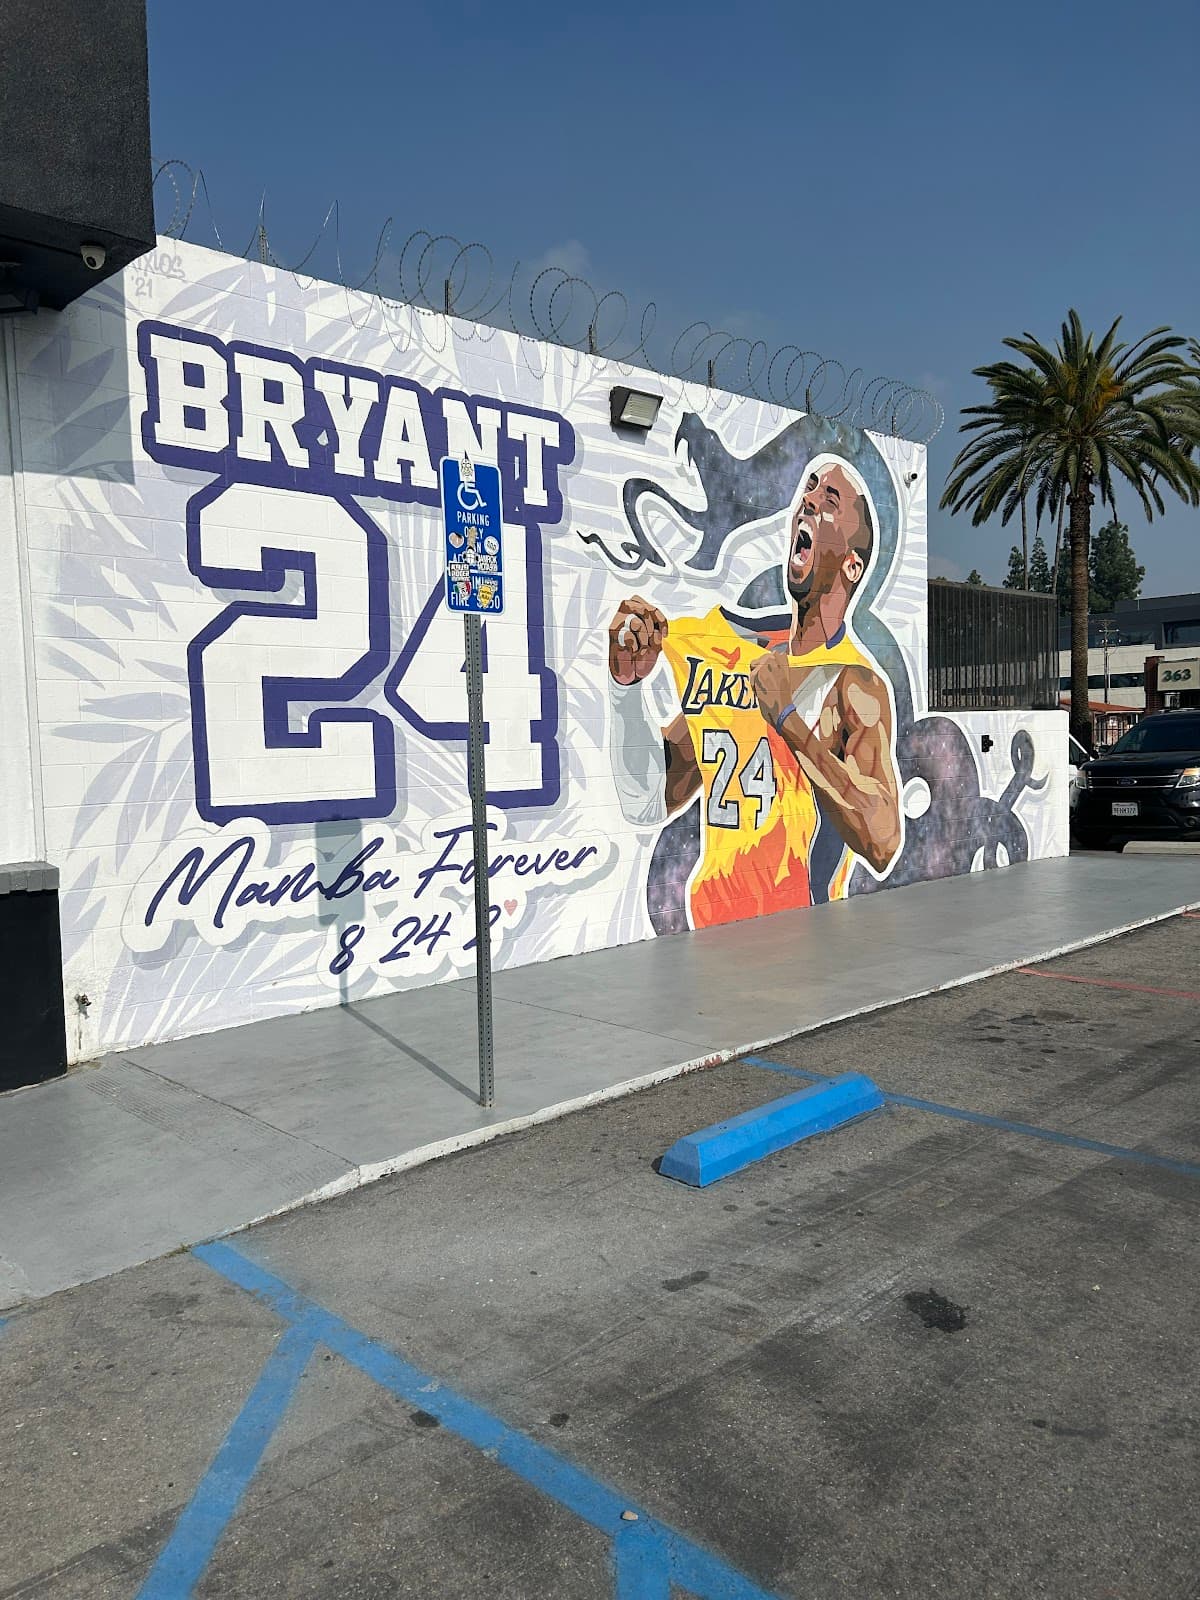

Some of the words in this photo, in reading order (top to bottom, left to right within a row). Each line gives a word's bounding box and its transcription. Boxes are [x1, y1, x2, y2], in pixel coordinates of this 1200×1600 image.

[143, 326, 567, 514] BRYANT
[456, 510, 490, 527] PARKING
[194, 478, 550, 818] 24
[681, 656, 759, 715] LAKE
[1162, 668, 1192, 682] 363
[701, 729, 777, 830] 24
[145, 836, 399, 928] Mamba
[329, 924, 363, 975] 8
[379, 912, 451, 964] 24
